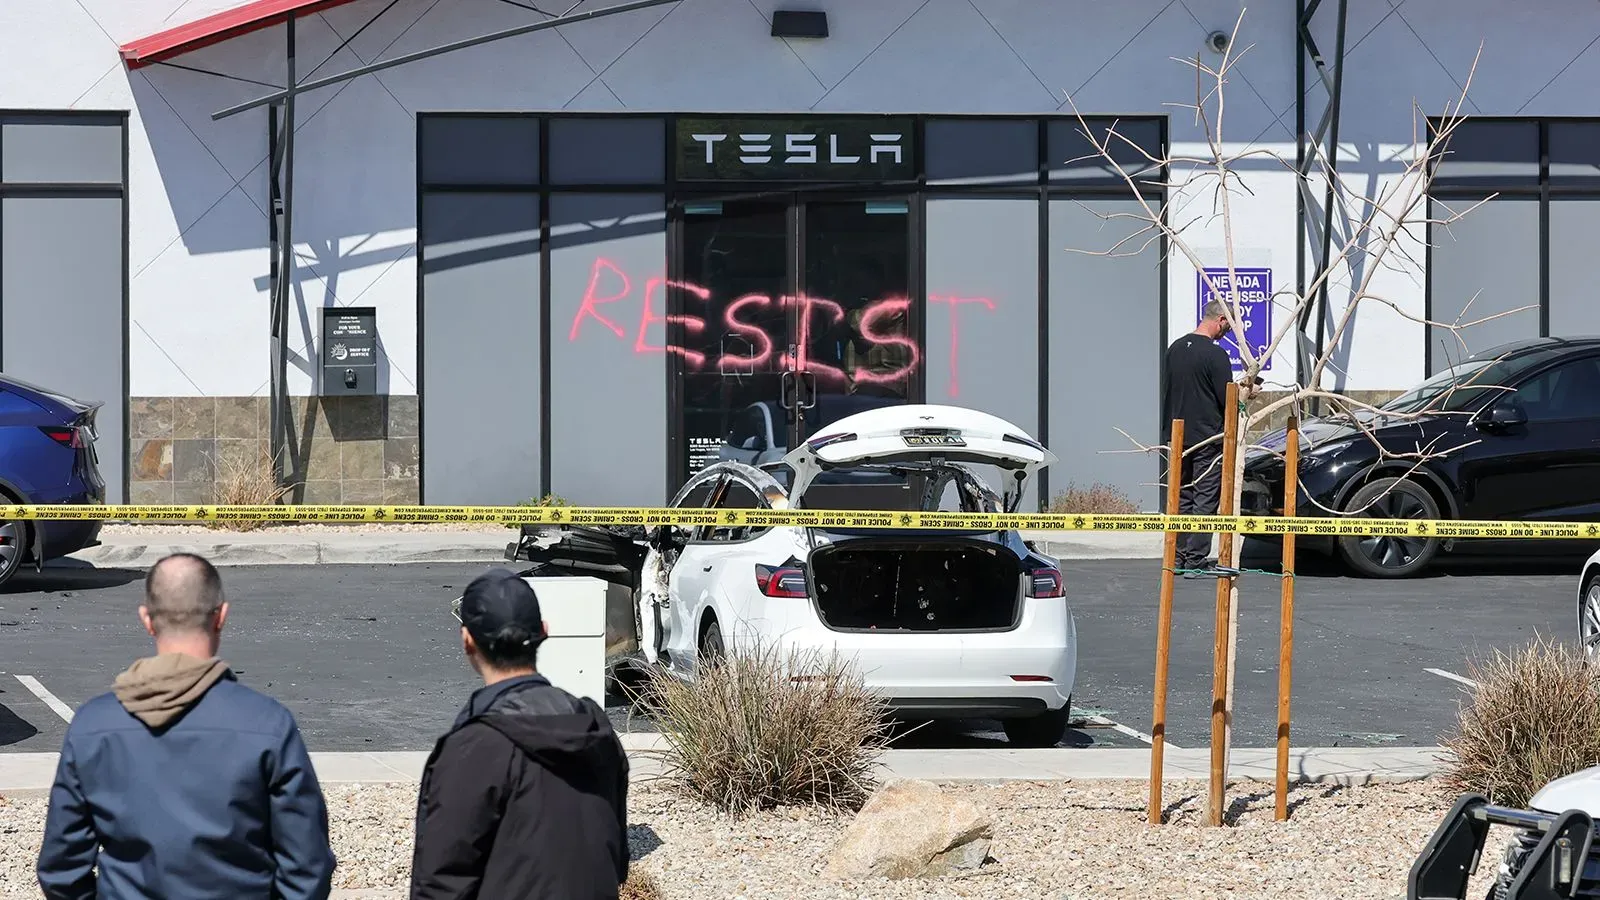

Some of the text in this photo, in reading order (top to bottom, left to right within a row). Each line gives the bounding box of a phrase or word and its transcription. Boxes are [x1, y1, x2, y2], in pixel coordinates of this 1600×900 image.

[691, 134, 902, 164] TESLA
[1212, 276, 1260, 288] NEADA
[1207, 291, 1265, 302] LCESED
[568, 256, 996, 397] RESIST
